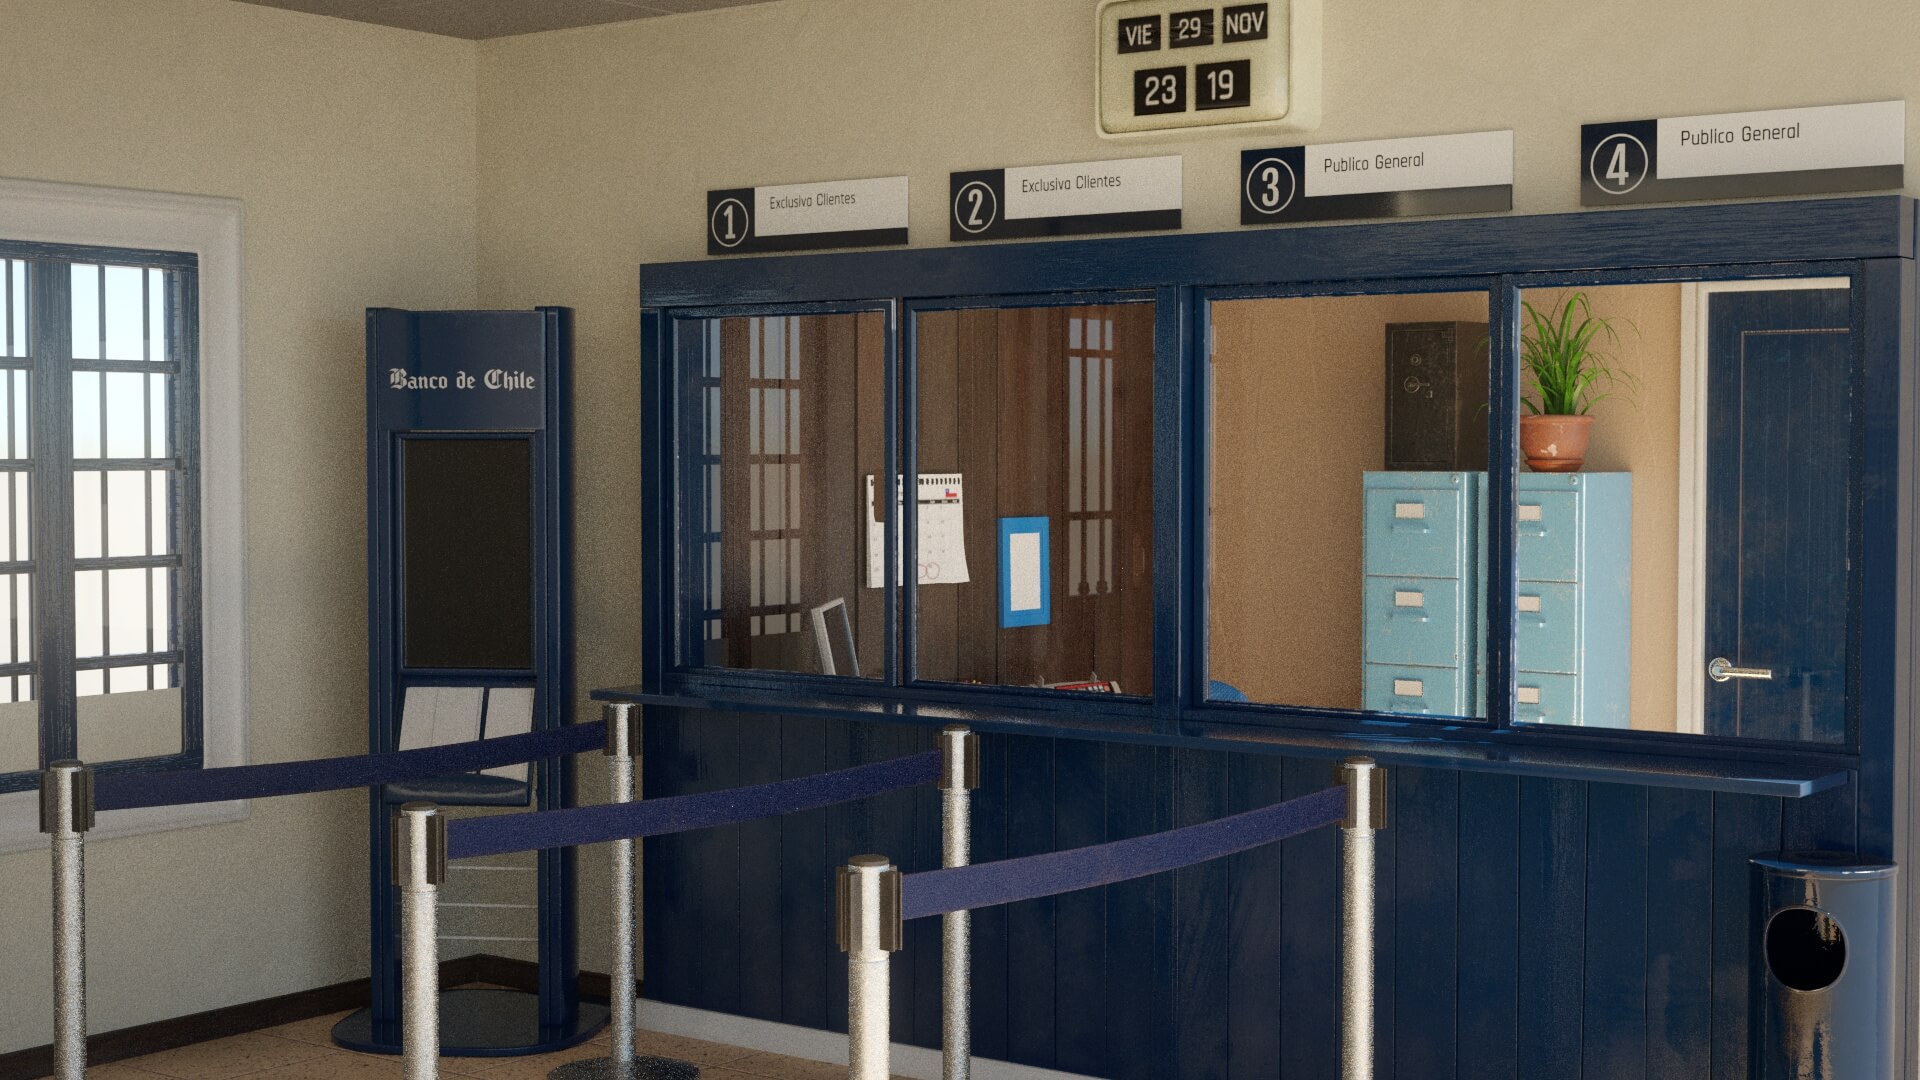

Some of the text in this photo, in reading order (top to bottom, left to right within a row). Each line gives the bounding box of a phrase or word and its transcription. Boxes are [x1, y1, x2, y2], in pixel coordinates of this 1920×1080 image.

[1125, 10, 1265, 47] VIE 29 NOV
[1144, 69, 1234, 107] 23 19
[1681, 122, 1800, 146] Publico General
[1324, 151, 1424, 173] Publico General
[1605, 142, 1630, 186] 4
[816, 193, 856, 207] Clientes
[1076, 174, 1122, 190] Clientes
[1261, 167, 1280, 207] 3
[723, 204, 736, 240] 1
[967, 188, 983, 226] 2
[389, 368, 536, 392] Banco de Chile
